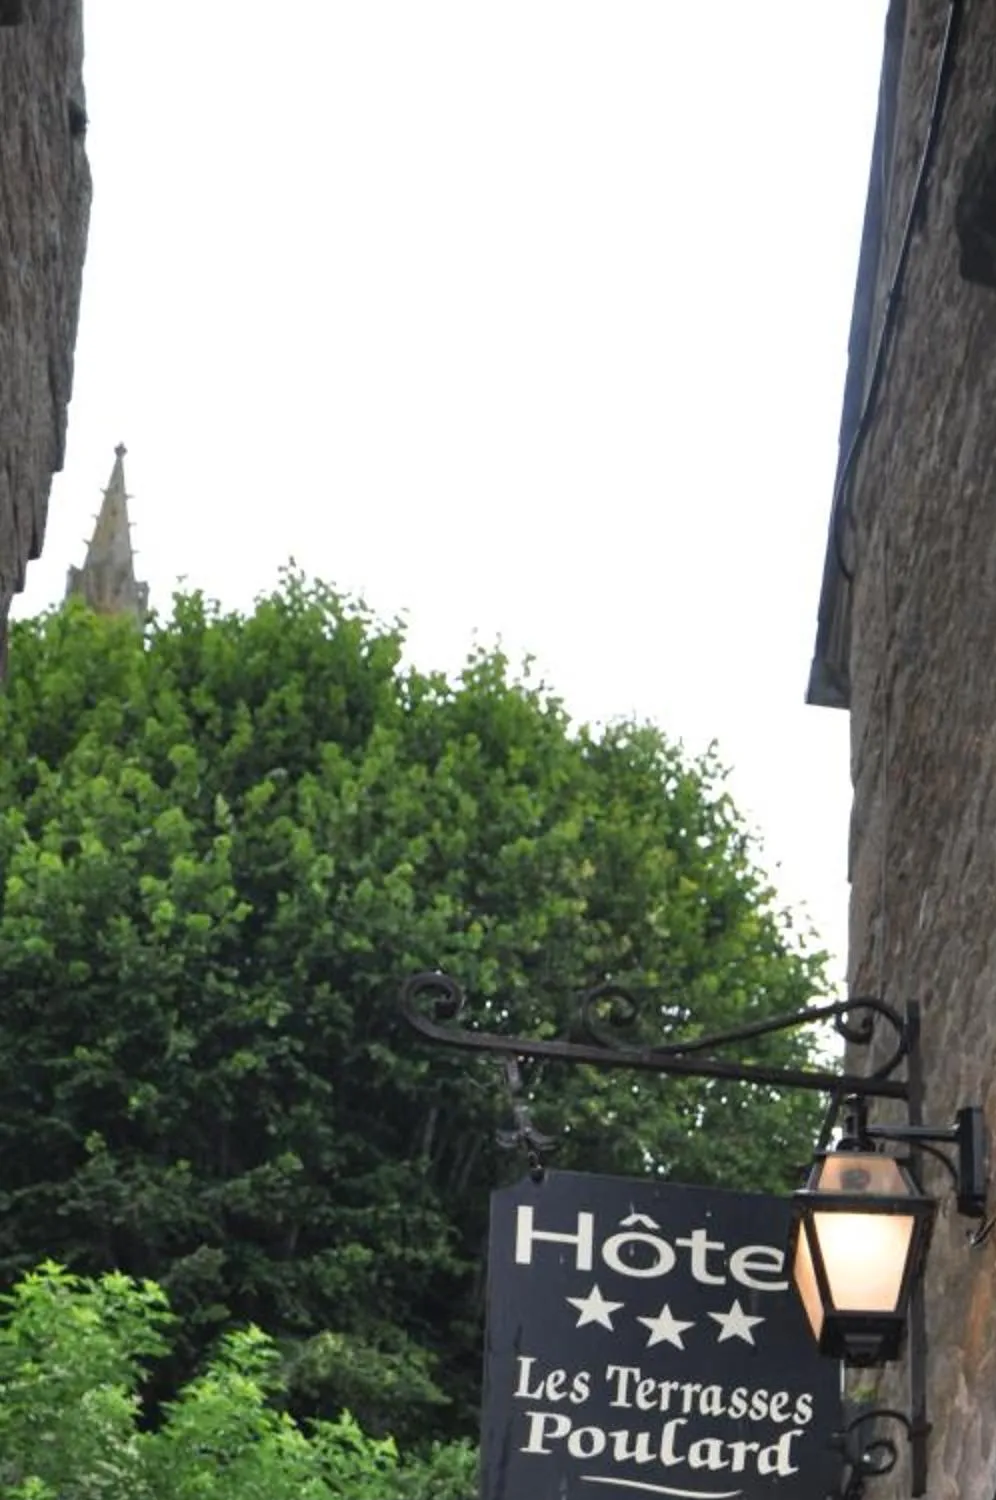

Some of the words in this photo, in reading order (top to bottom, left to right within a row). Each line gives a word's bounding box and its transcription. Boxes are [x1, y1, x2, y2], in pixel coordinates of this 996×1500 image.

[515, 1205, 789, 1291] Hôte
[513, 1356, 590, 1404] Les
[605, 1365, 813, 1424] Terrasses
[519, 1411, 804, 1477] Poulard
